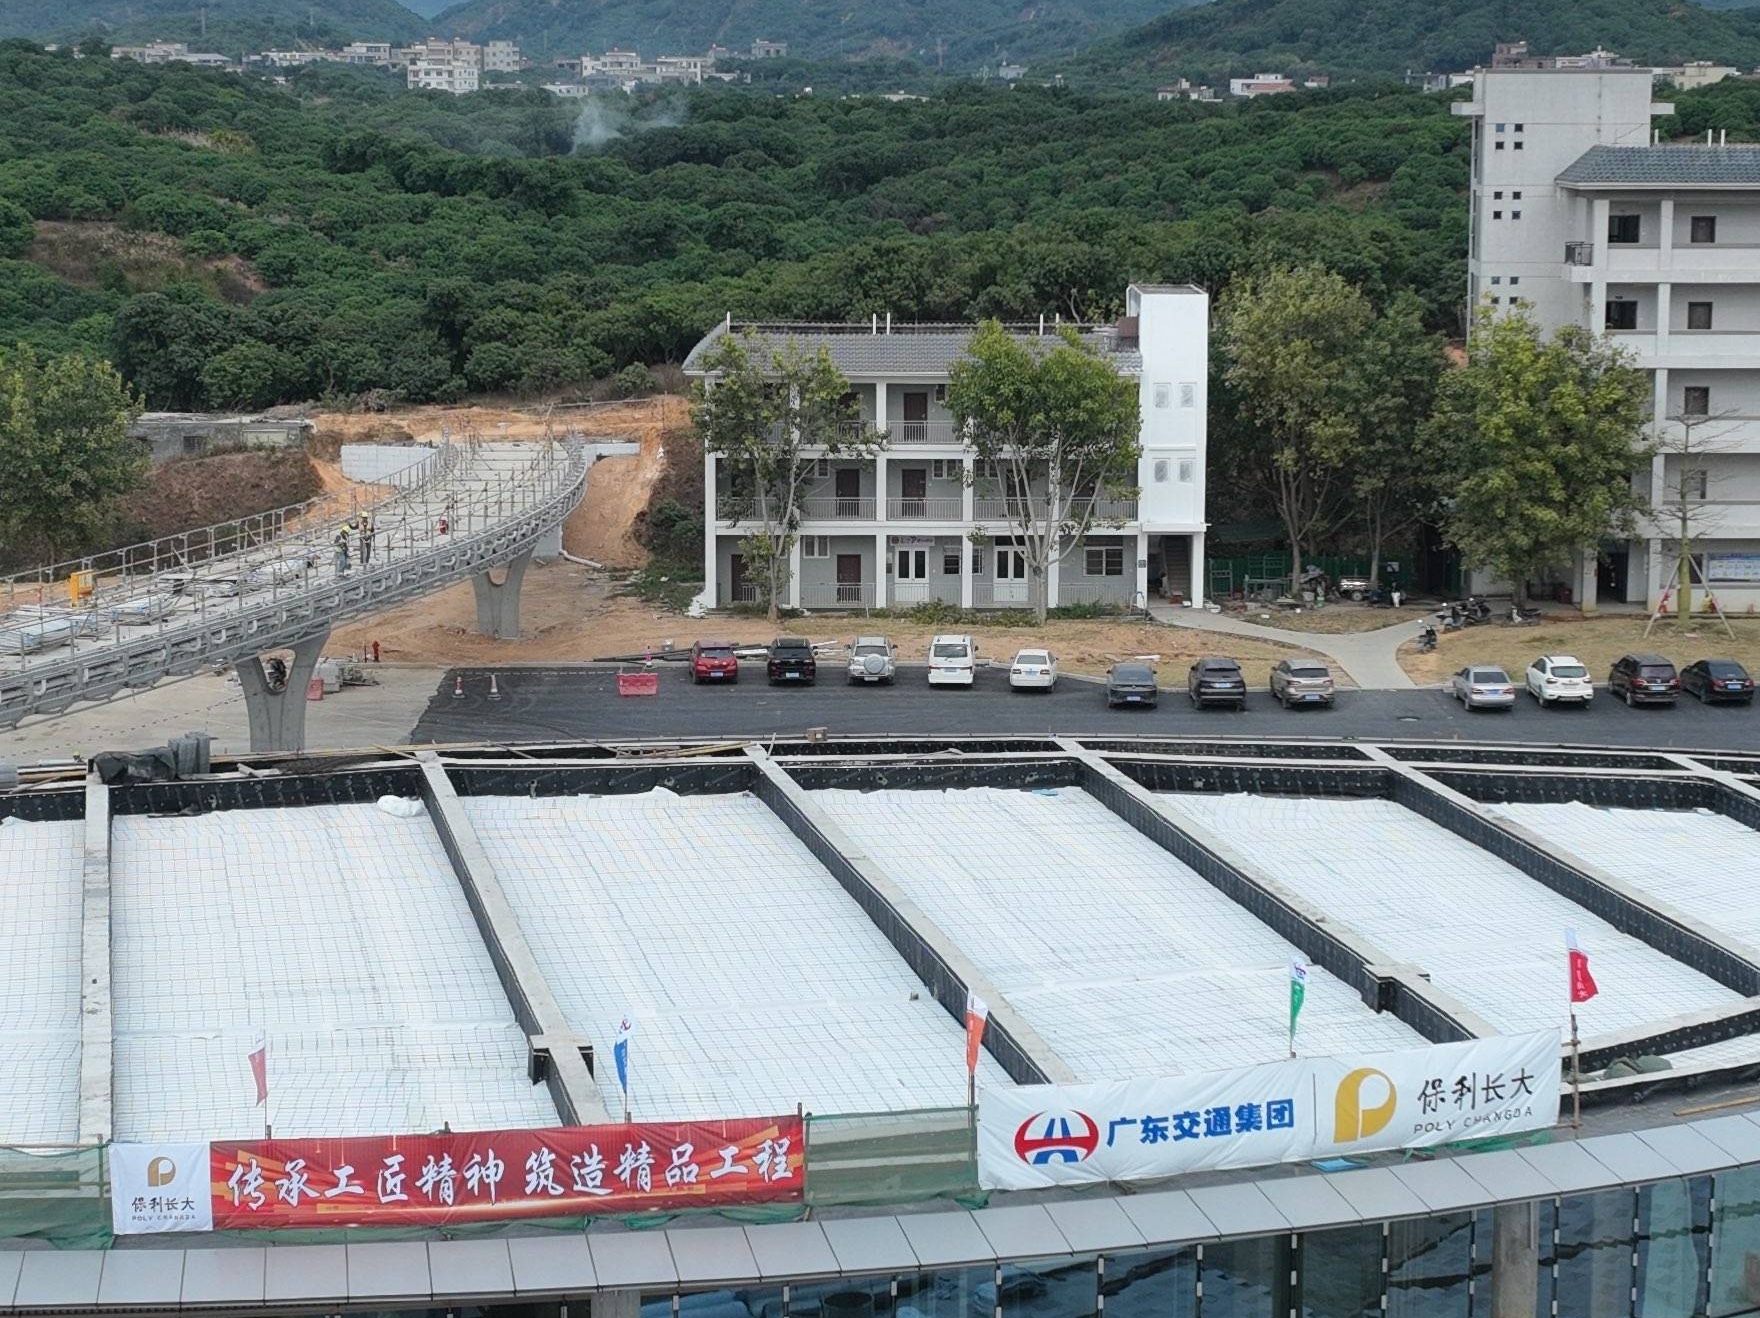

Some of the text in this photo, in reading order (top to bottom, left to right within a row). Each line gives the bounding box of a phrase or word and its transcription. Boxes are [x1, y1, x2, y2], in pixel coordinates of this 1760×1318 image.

[1417, 1067, 1534, 1115] 保利长大
[1106, 1098, 1295, 1147] 广东交通集团
[1413, 1106, 1533, 1134] POLY CHANGDA
[227, 1136, 794, 1212] 传承工匠精神 筑造精品工程
[131, 1196, 195, 1213] 保利长大
